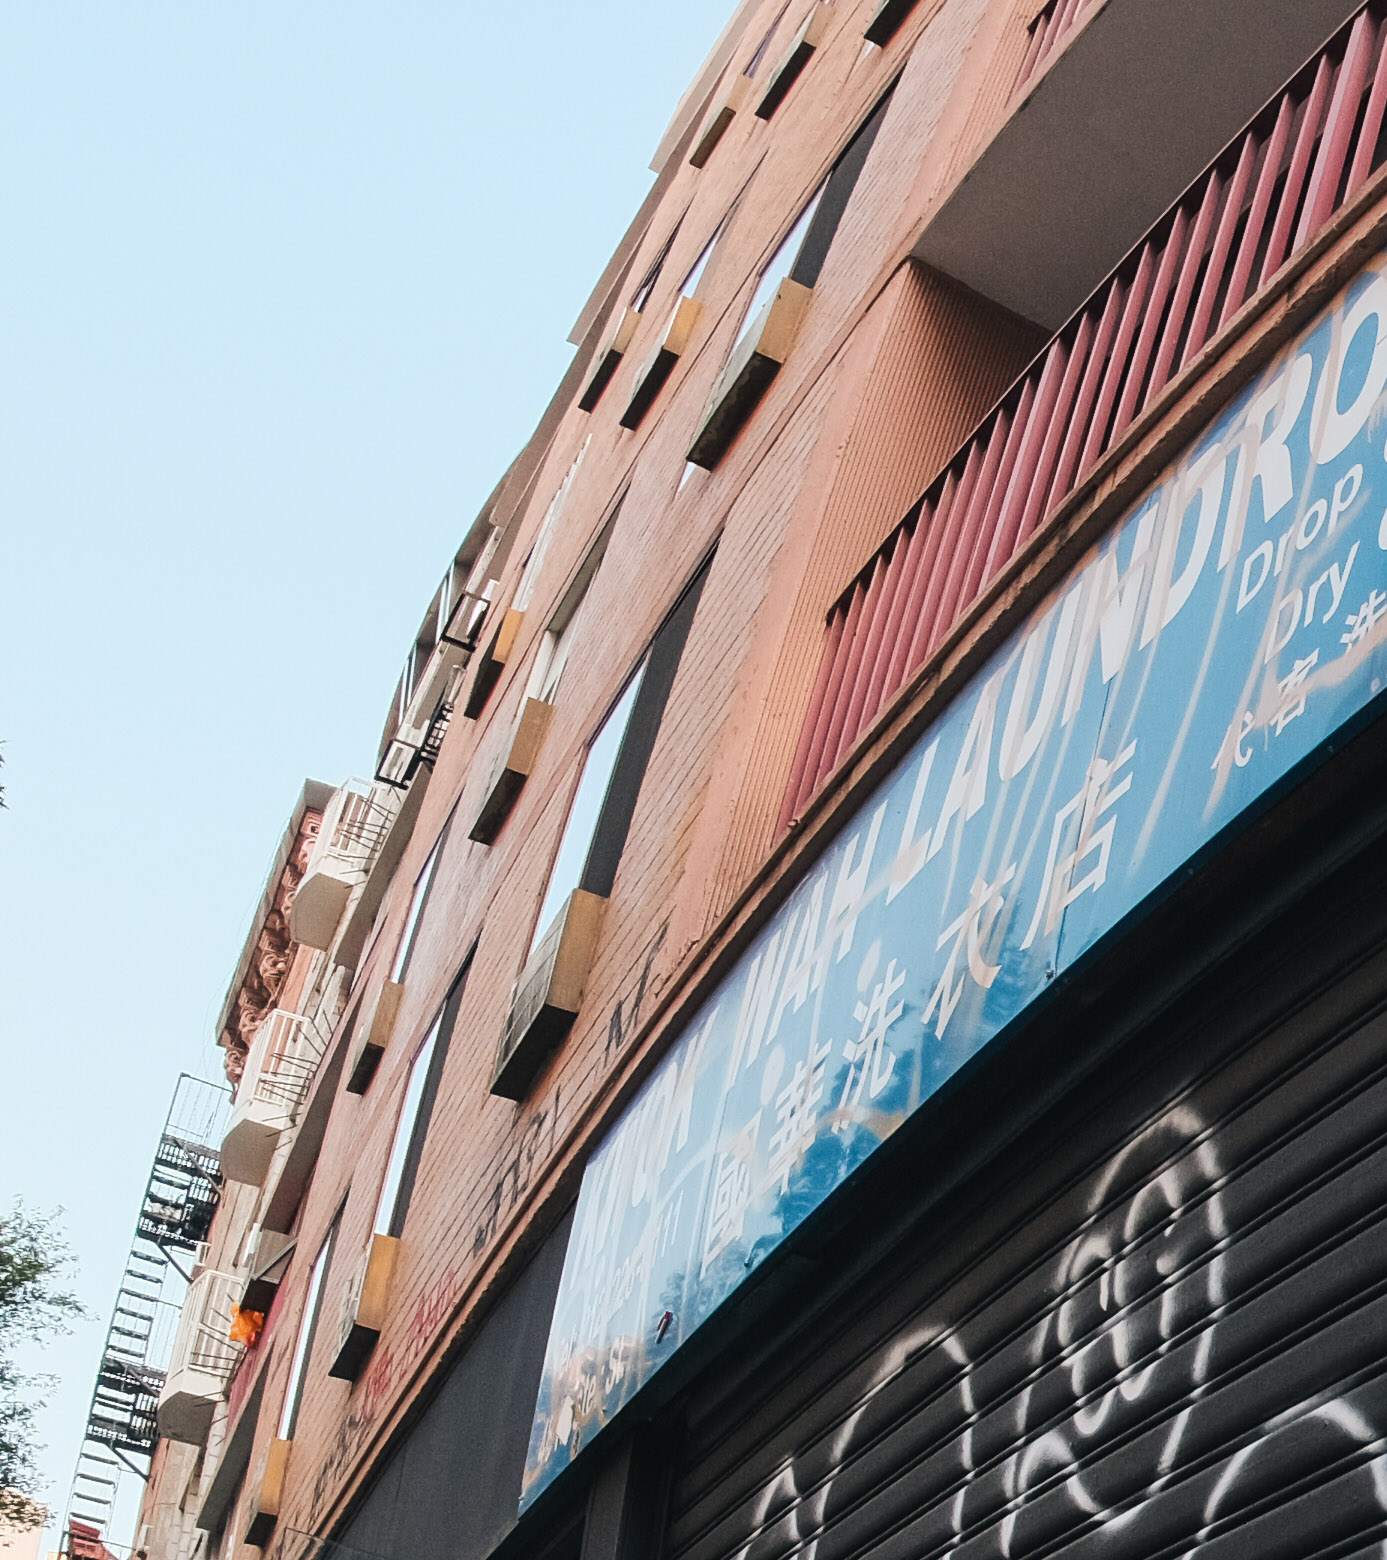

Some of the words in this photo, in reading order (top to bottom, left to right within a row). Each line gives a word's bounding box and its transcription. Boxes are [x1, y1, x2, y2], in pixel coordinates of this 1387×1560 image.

[1236, 464, 1362, 615] Drop
[1264, 541, 1360, 665] Dry
[726, 800, 888, 1090] WAH
